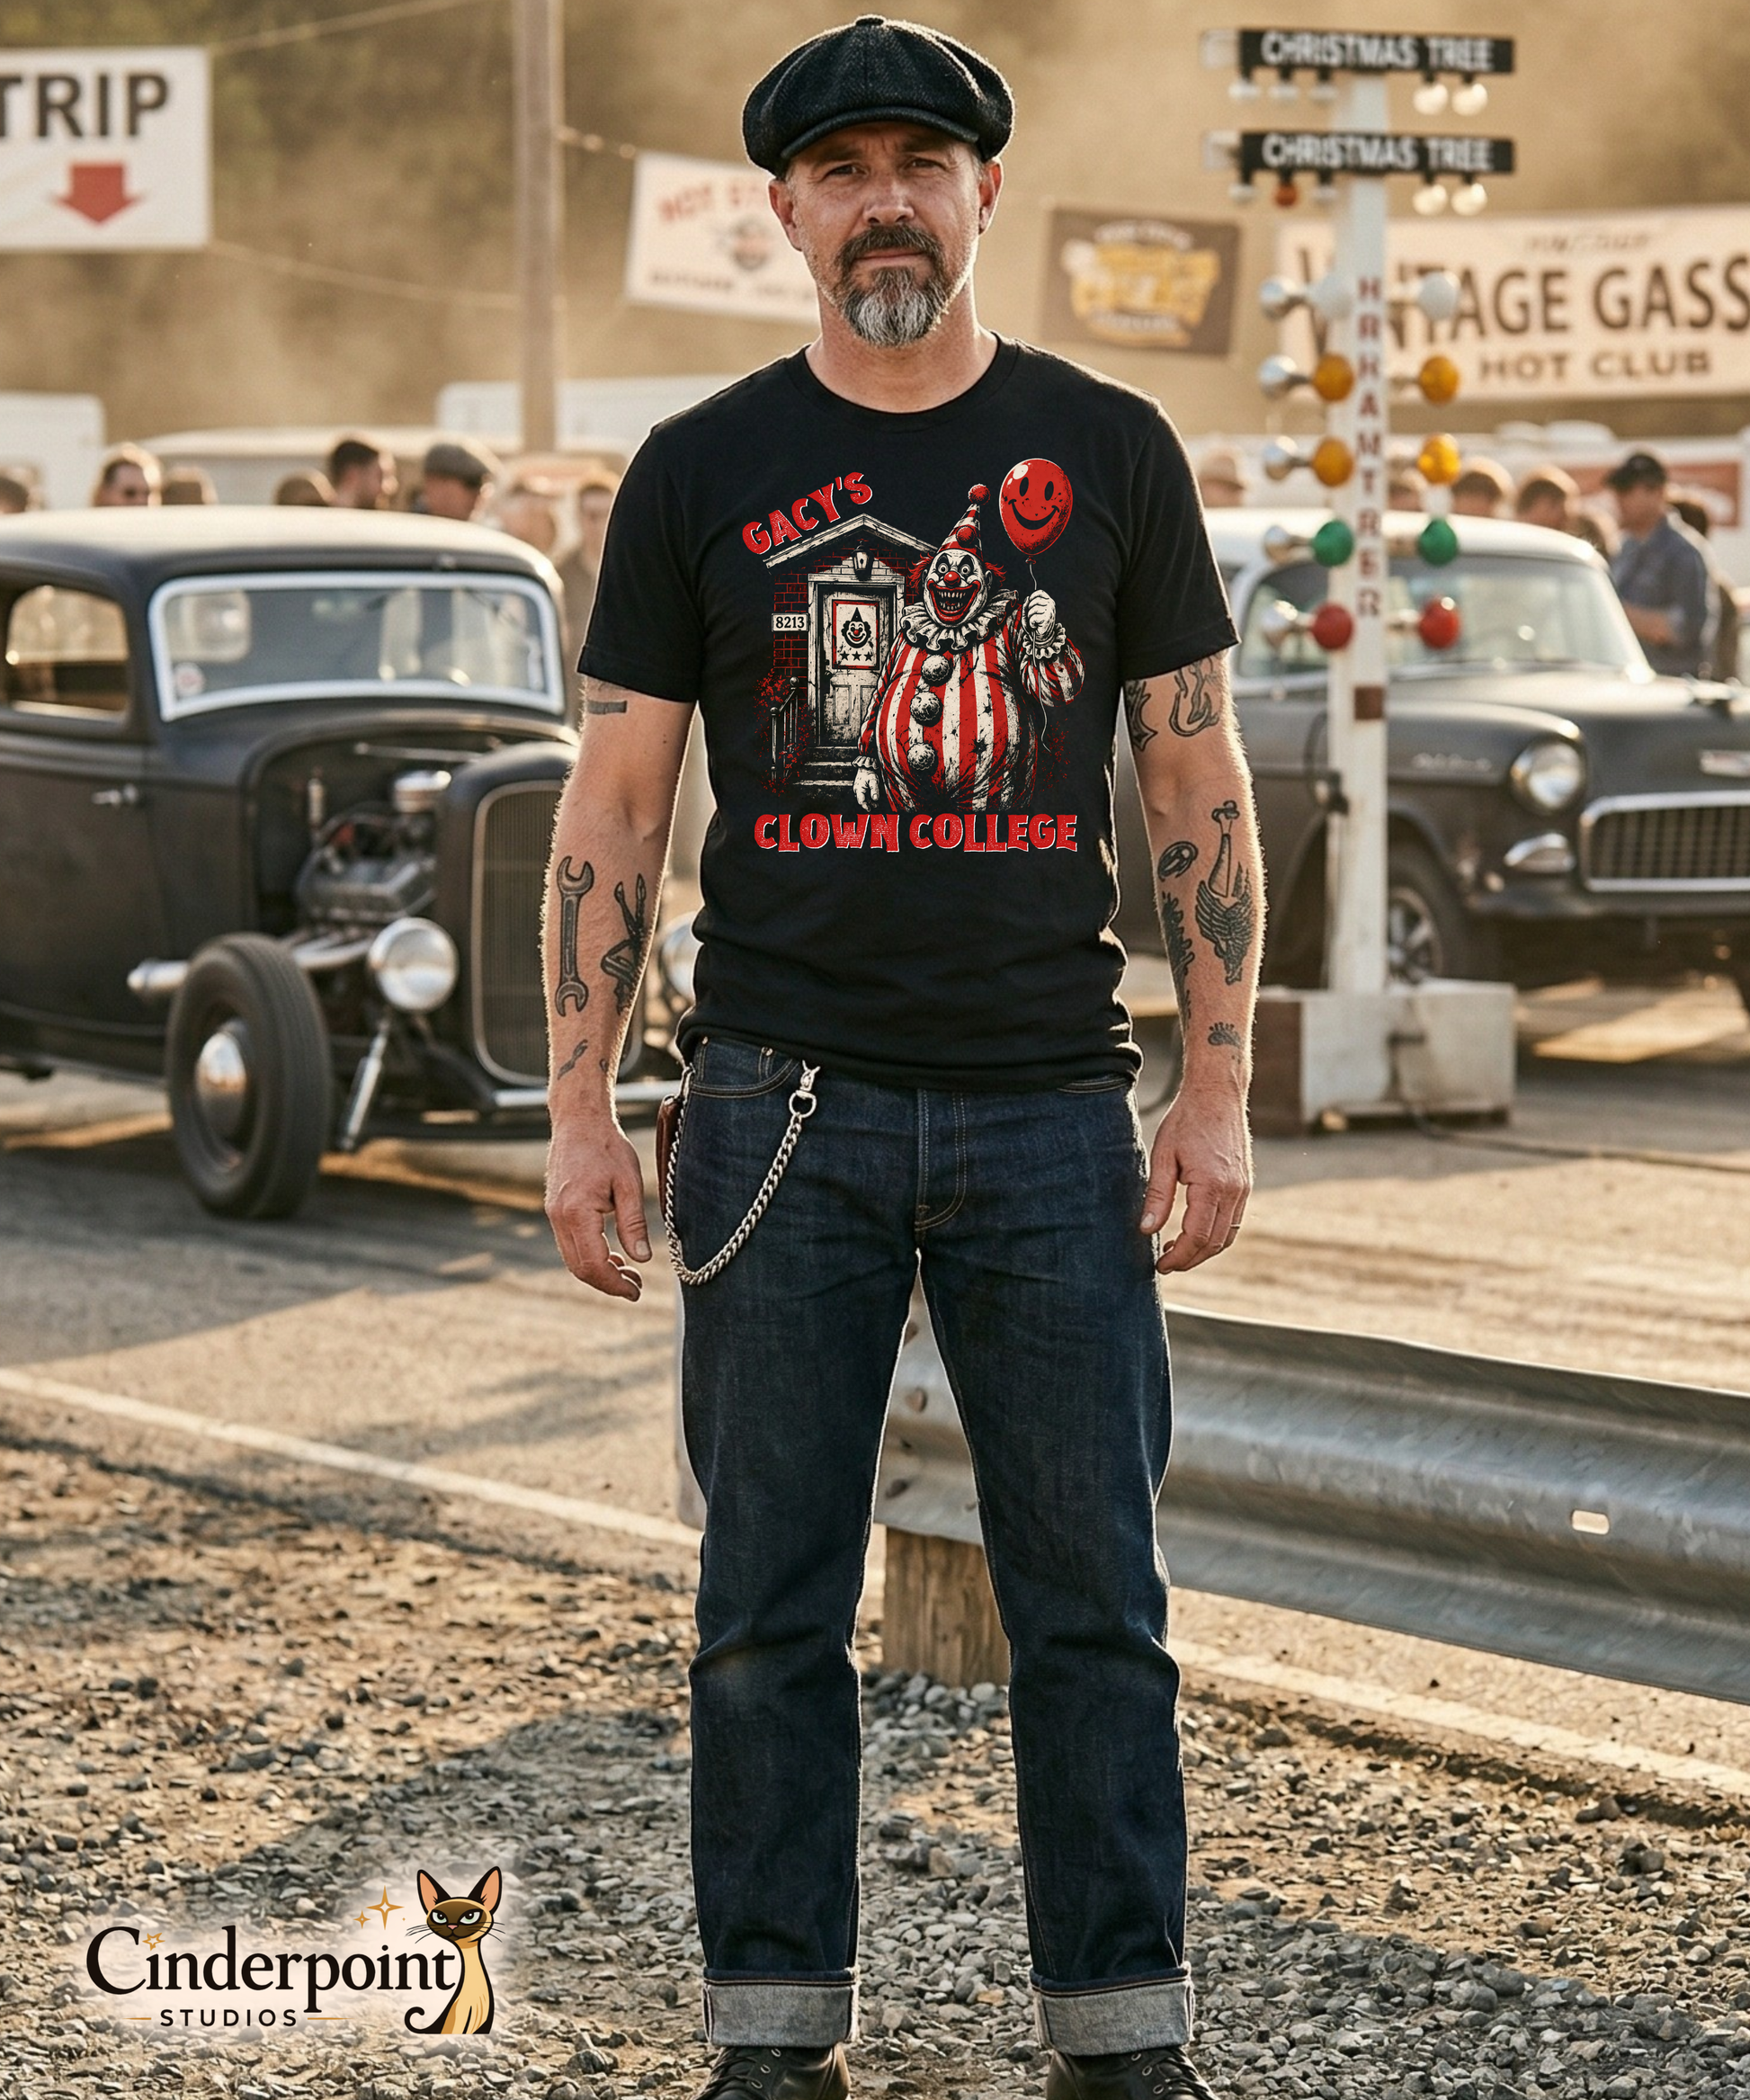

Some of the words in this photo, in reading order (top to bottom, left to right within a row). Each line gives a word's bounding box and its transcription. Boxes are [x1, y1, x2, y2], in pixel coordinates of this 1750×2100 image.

[1261, 30, 1419, 67] CHRISTMAS
[1426, 37, 1494, 71] TREE
[0, 74, 170, 138] TRIP
[1261, 132, 1419, 169] CHRISTMAS
[1426, 138, 1494, 172] TREE
[1591, 255, 1750, 332] GASS
[1479, 353, 1568, 381] HOT
[1590, 350, 1711, 378] CLUB
[742, 471, 873, 555] GACY'S
[775, 616, 805, 629] 8213
[754, 813, 899, 853] CLOWN
[909, 813, 1078, 853] COLLEGE
